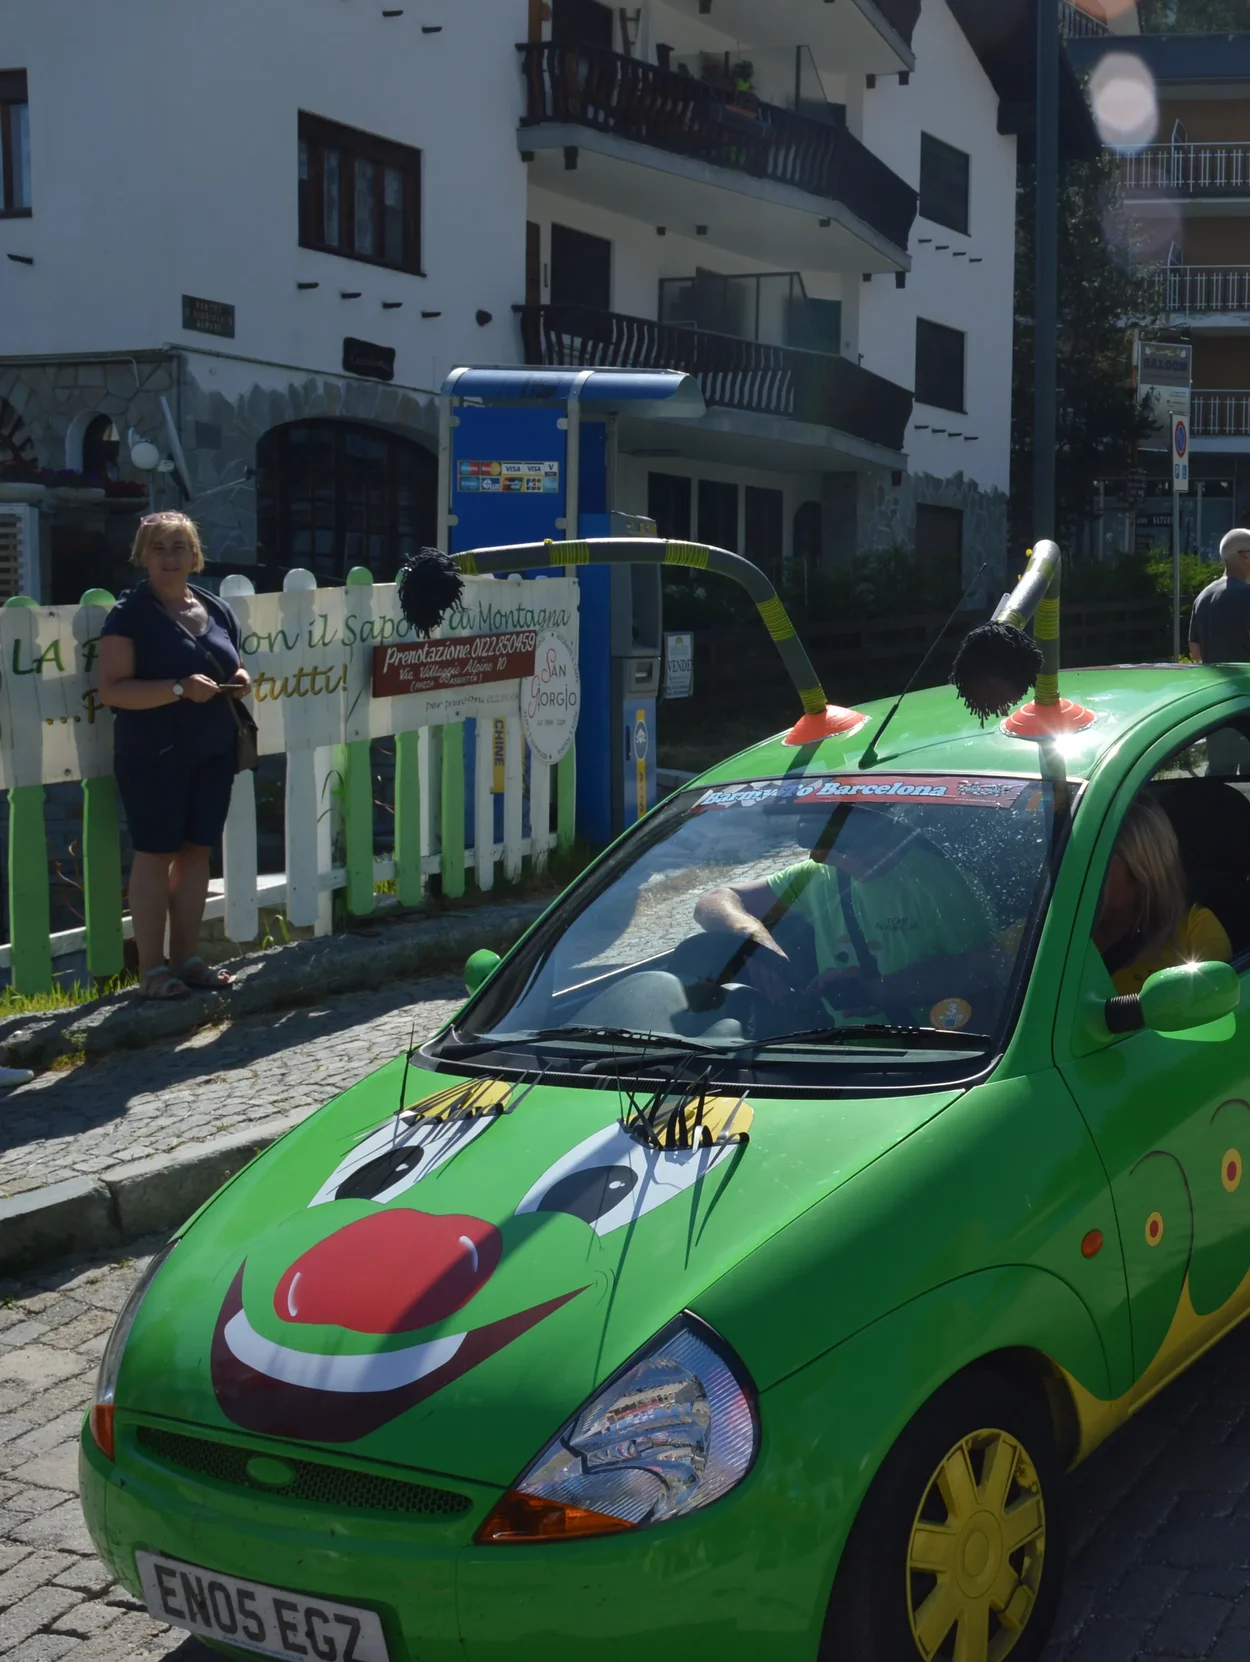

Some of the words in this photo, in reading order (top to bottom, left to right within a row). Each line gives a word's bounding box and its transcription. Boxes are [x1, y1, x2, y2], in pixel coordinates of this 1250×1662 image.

[13, 637, 65, 675] LA
[242, 629, 299, 655] on
[308, 613, 338, 648] il
[342, 614, 410, 646] Sapo
[479, 602, 571, 632] Montagna
[254, 662, 348, 702] tutti!
[399, 668, 415, 681] Via
[463, 659, 493, 677] Alpino
[541, 648, 567, 684] SAN
[816, 781, 949, 797] Barcelona
[154, 1563, 267, 1644] EN05
[272, 1596, 368, 1662] EGZ
